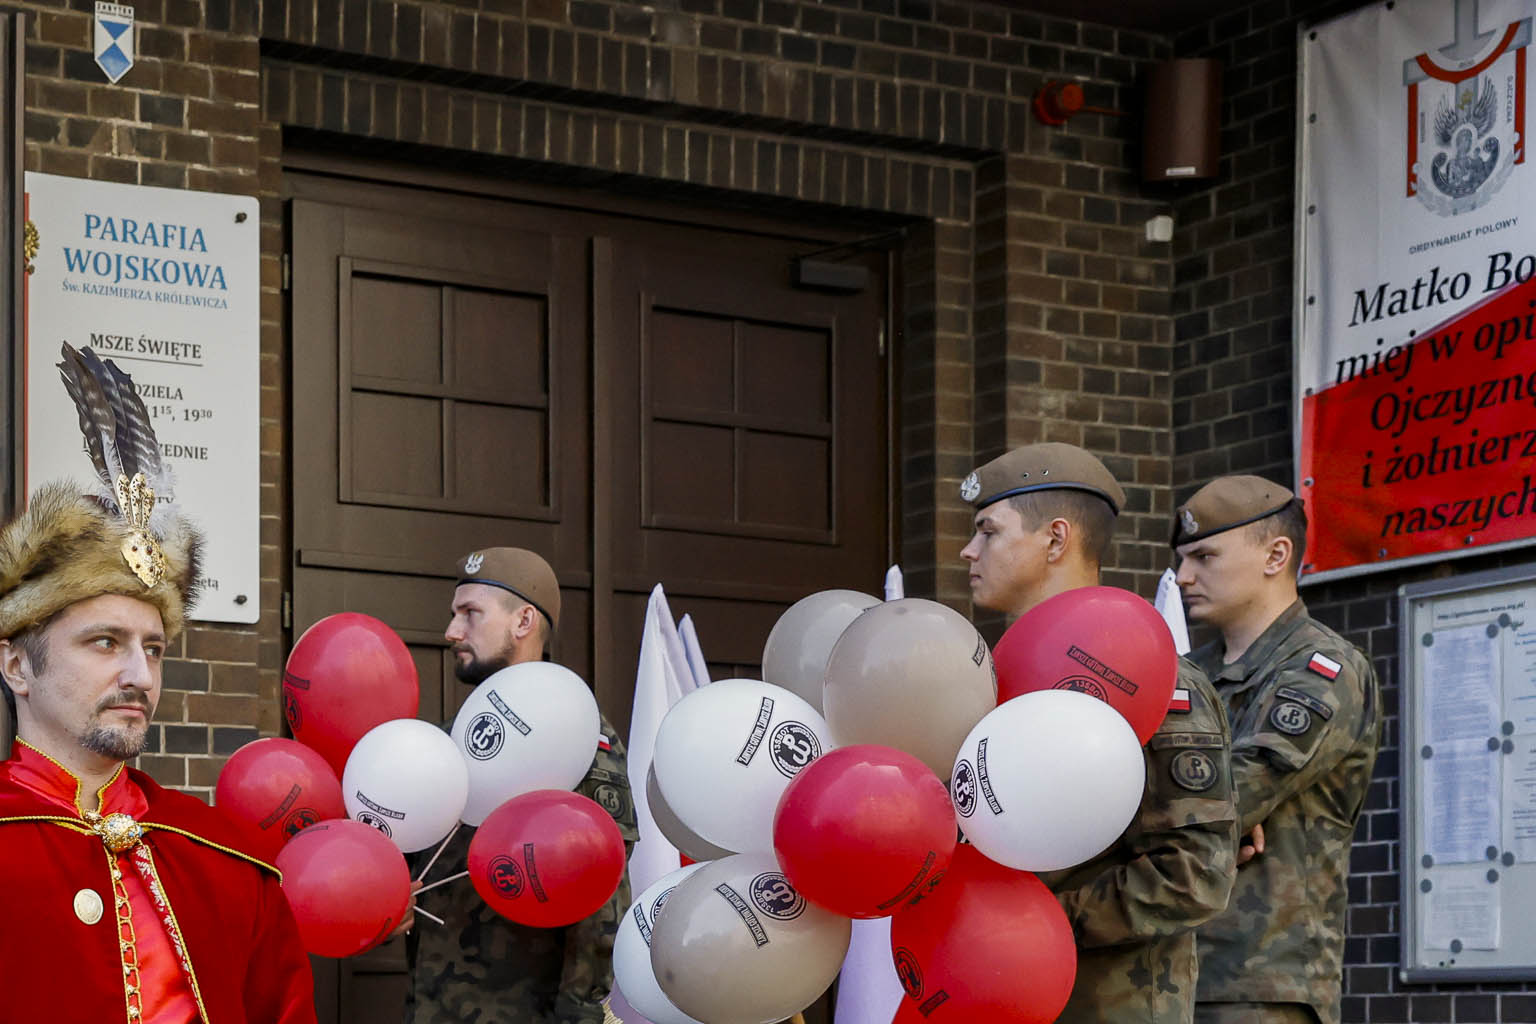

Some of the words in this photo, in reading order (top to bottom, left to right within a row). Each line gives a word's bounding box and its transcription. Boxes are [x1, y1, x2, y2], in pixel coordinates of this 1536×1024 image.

[84, 213, 208, 252] PARAFIA
[1409, 230, 1472, 255] ORDYNARIAT
[1476, 217, 1518, 236] POLOWY
[63, 247, 228, 290] WOJSKOWA
[82, 283, 152, 301] KAZIMIERZA
[155, 290, 228, 309] KRÓLEWICZA
[1348, 266, 1471, 327] Matko
[1482, 252, 1536, 293] Bo
[90, 333, 134, 352] MSZE
[138, 334, 202, 360] ŚWIĘTE
[1336, 330, 1416, 384] miej
[1428, 331, 1464, 362] w
[134, 383, 184, 400] DZIELA
[1362, 450, 1374, 488] i
